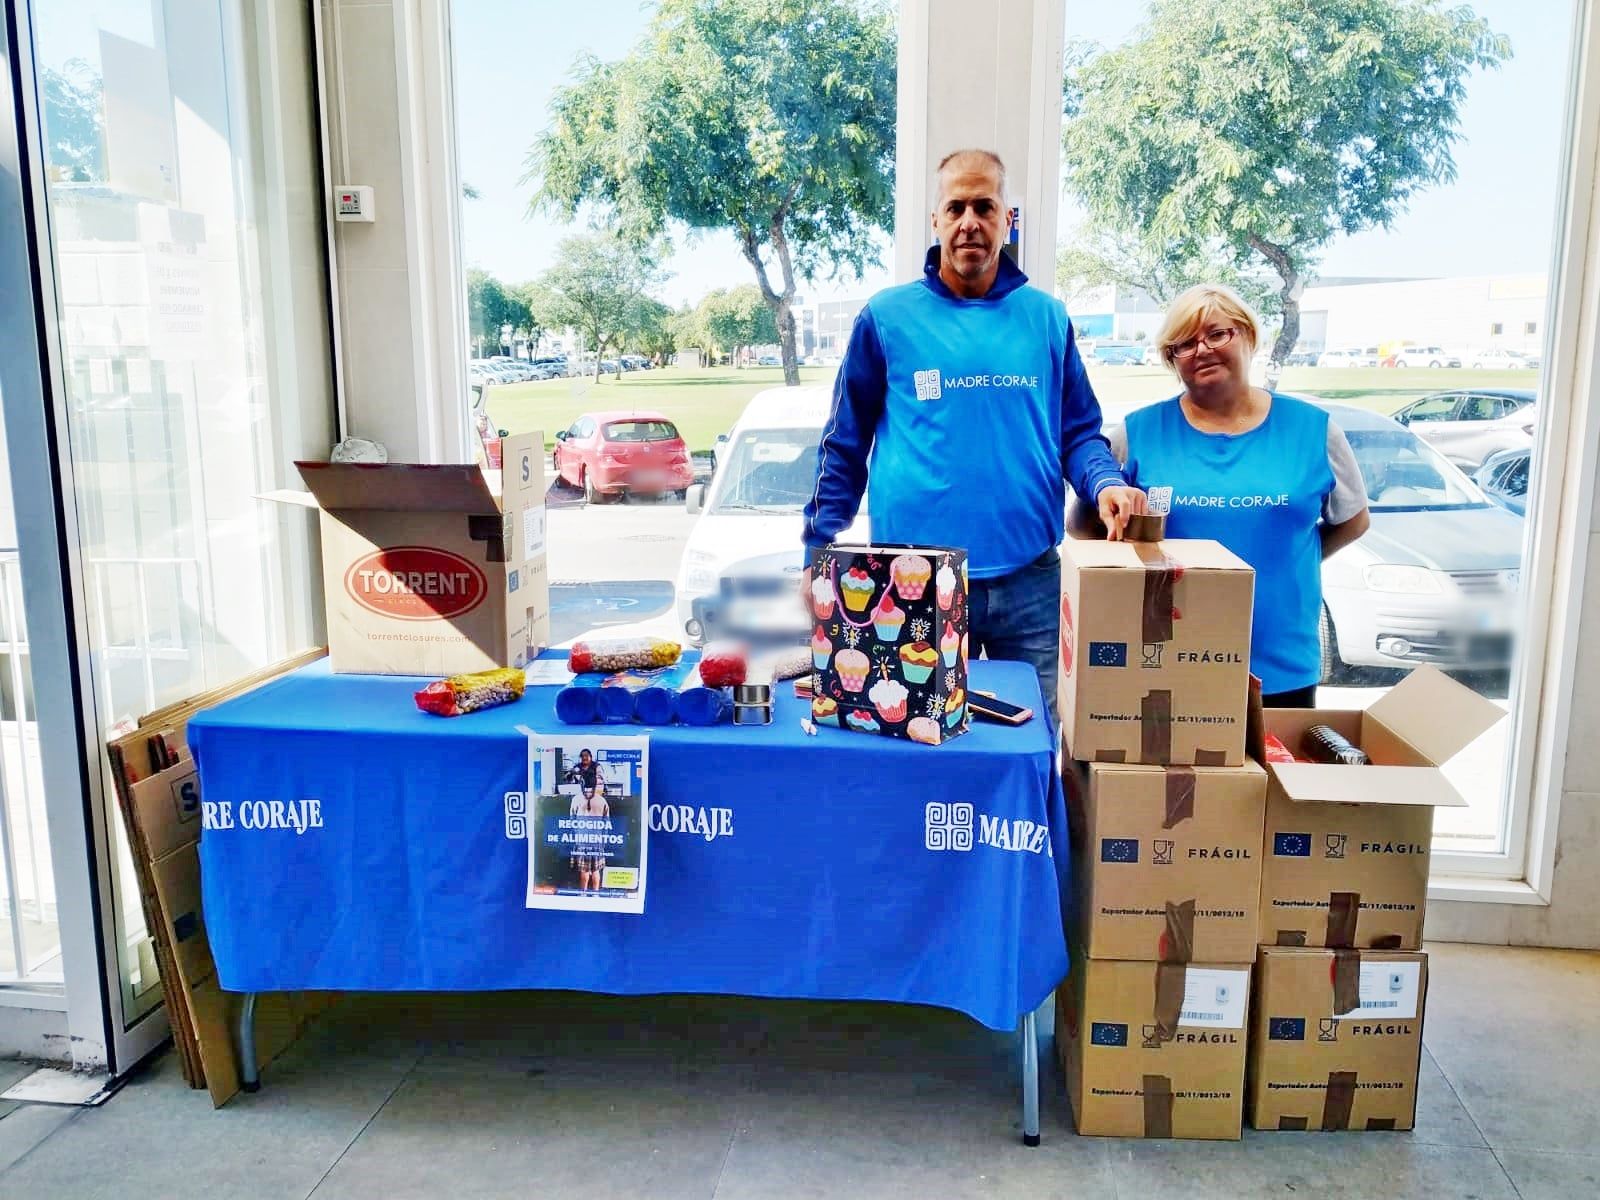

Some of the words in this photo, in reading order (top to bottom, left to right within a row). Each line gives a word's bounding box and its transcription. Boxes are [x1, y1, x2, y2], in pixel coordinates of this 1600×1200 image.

[944, 375, 990, 389] MADRE
[992, 374, 1039, 388] CORAJE
[522, 456, 530, 481] S
[1174, 495, 1226, 508] MADRE
[1229, 494, 1289, 508] CORAJE
[359, 570, 470, 595] TORRENT
[367, 631, 473, 644] torrentclosures.com
[1177, 650, 1243, 664] FRÁGIL
[239, 799, 323, 835] CORAJE
[648, 804, 734, 841] CORAJE
[558, 819, 613, 830] RECOGIDA
[547, 834, 559, 842] DE
[561, 832, 624, 844] ALIMENTOS
[1188, 846, 1251, 859] FRÁGIL
[1360, 841, 1425, 855] FRÁGIL
[1352, 1024, 1412, 1036] FRÁGIL
[1177, 1031, 1238, 1044] FRÁGIL
